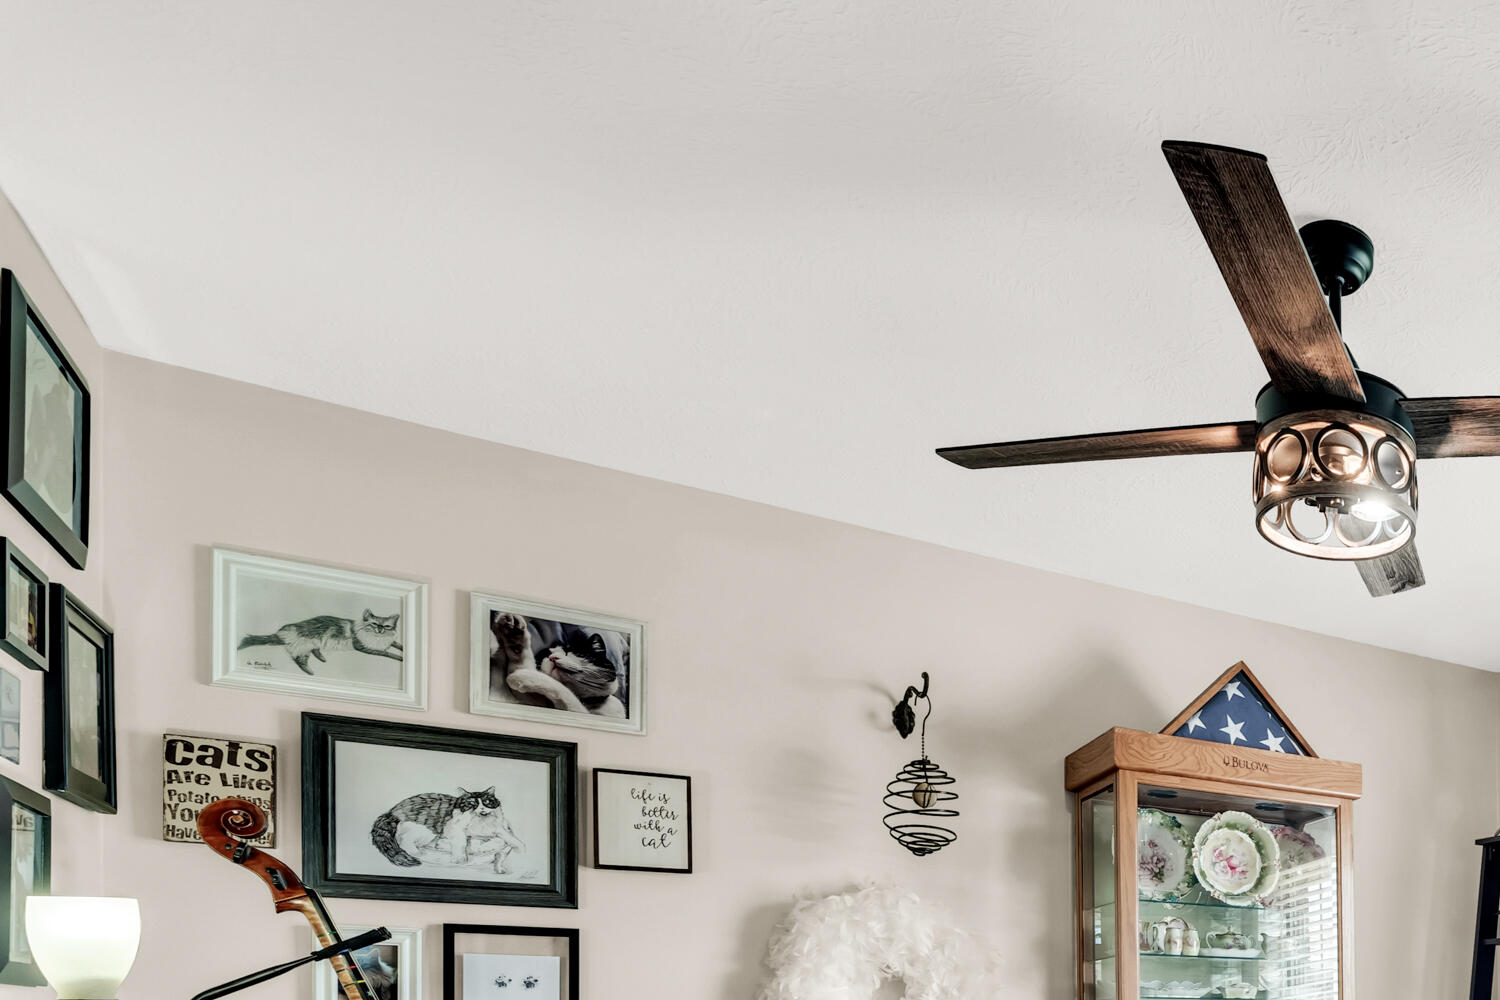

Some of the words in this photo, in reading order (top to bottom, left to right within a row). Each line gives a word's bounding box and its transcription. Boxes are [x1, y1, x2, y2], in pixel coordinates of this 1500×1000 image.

[167, 769, 211, 786] Are
[219, 772, 272, 791] Like
[659, 793, 670, 804] is
[642, 806, 679, 820] better
[634, 820, 664, 832] with
[667, 828, 678, 836] a
[642, 833, 671, 849] cat
